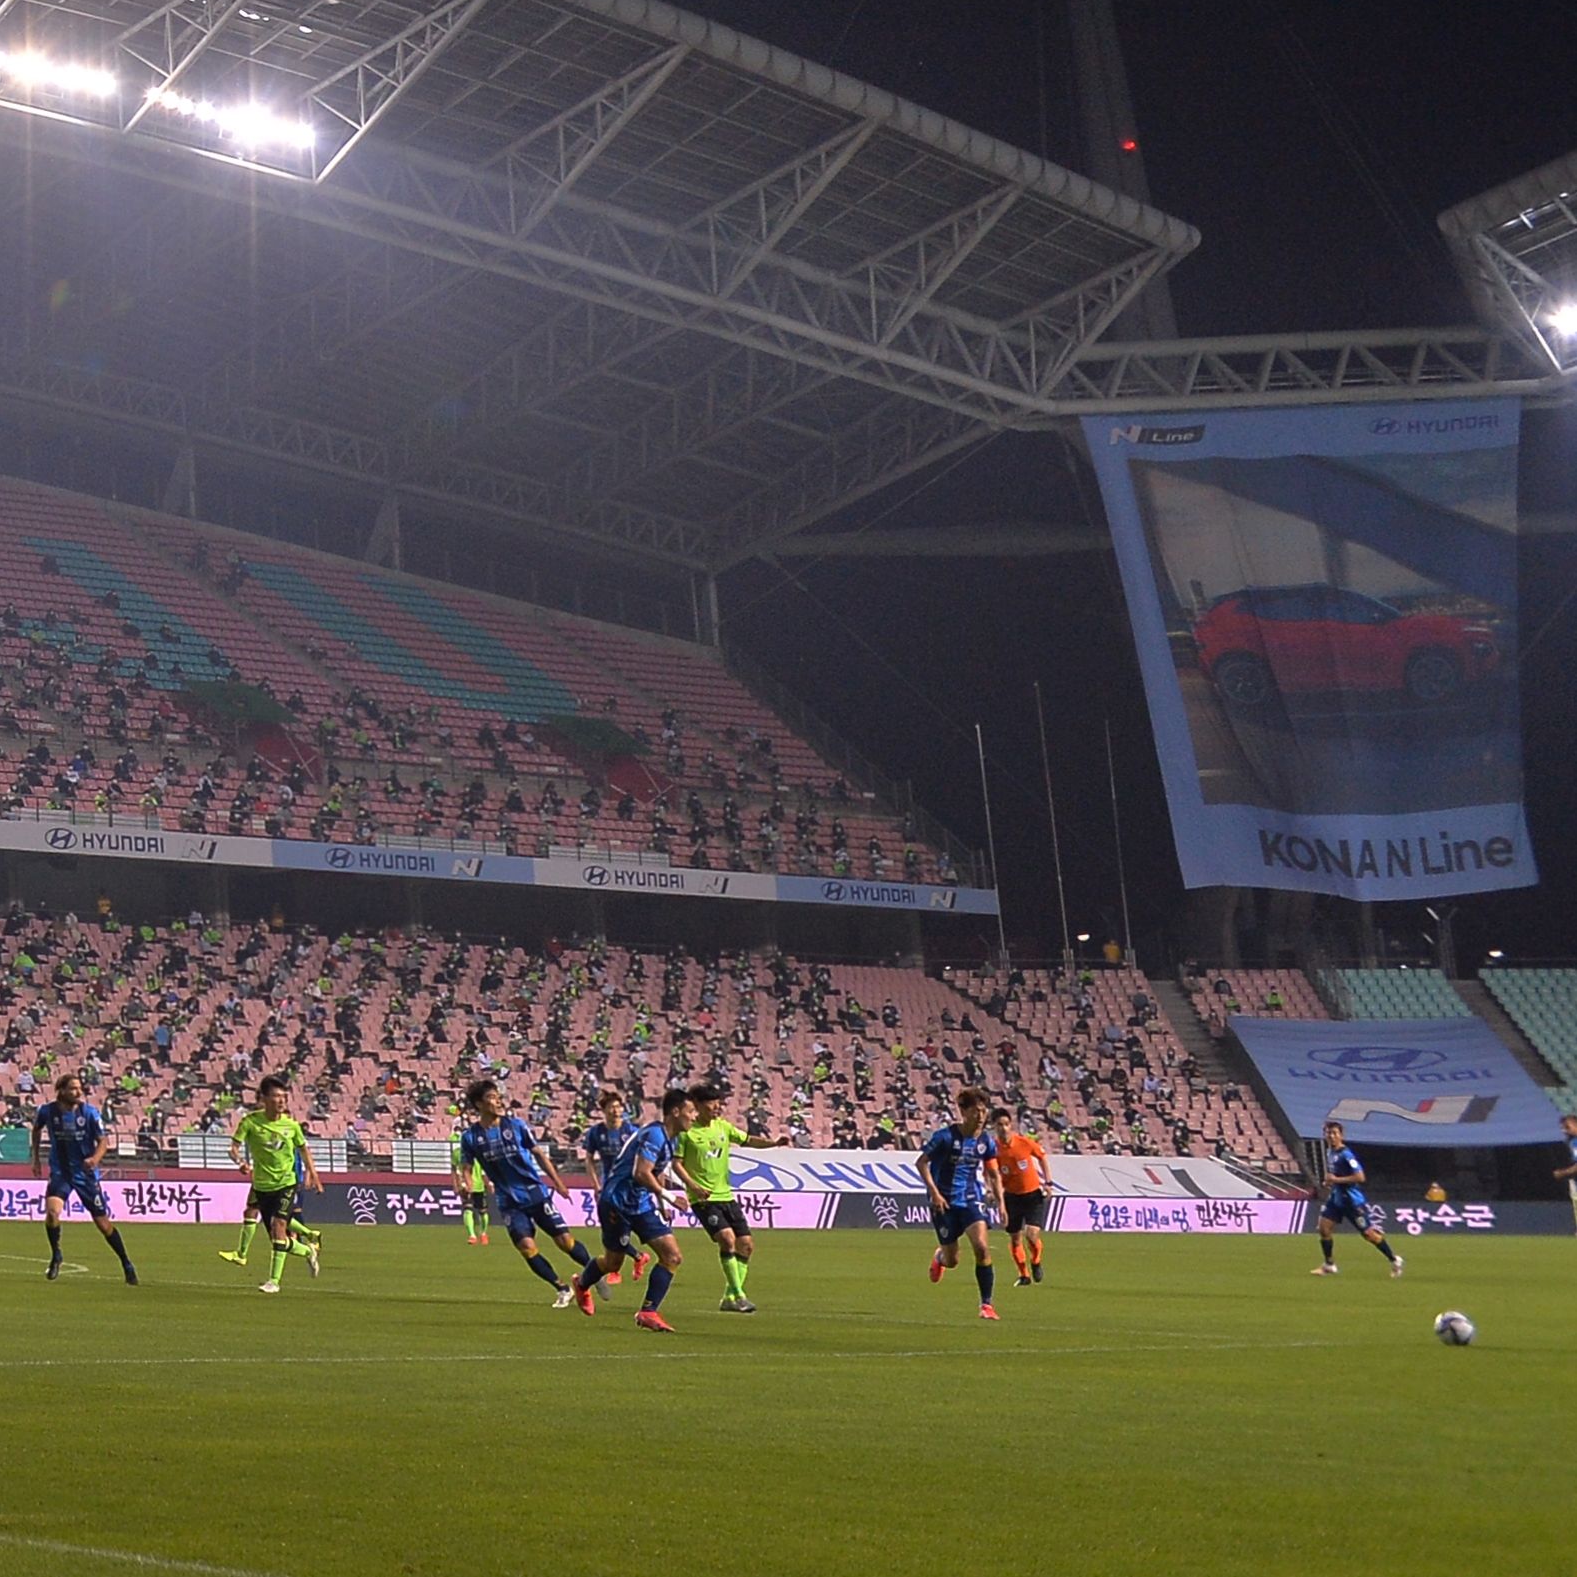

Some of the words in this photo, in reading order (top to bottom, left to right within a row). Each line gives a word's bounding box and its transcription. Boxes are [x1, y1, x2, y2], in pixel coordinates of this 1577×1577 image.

[1407, 415, 1500, 435] HYUNDAI
[1151, 430, 1196, 444] Line
[82, 832, 164, 854] HYUNDAI
[1419, 831, 1515, 875] Line
[359, 852, 435, 872] HYUNDAI
[614, 870, 685, 890] HYUNDAI
[850, 885, 916, 904] HYUNDAI
[1287, 1066, 1497, 1084] HYUNDAI
[386, 1188, 463, 1225] 장수군
[1135, 1205, 1170, 1230] 미래의
[1395, 1203, 1496, 1236] 장수군
